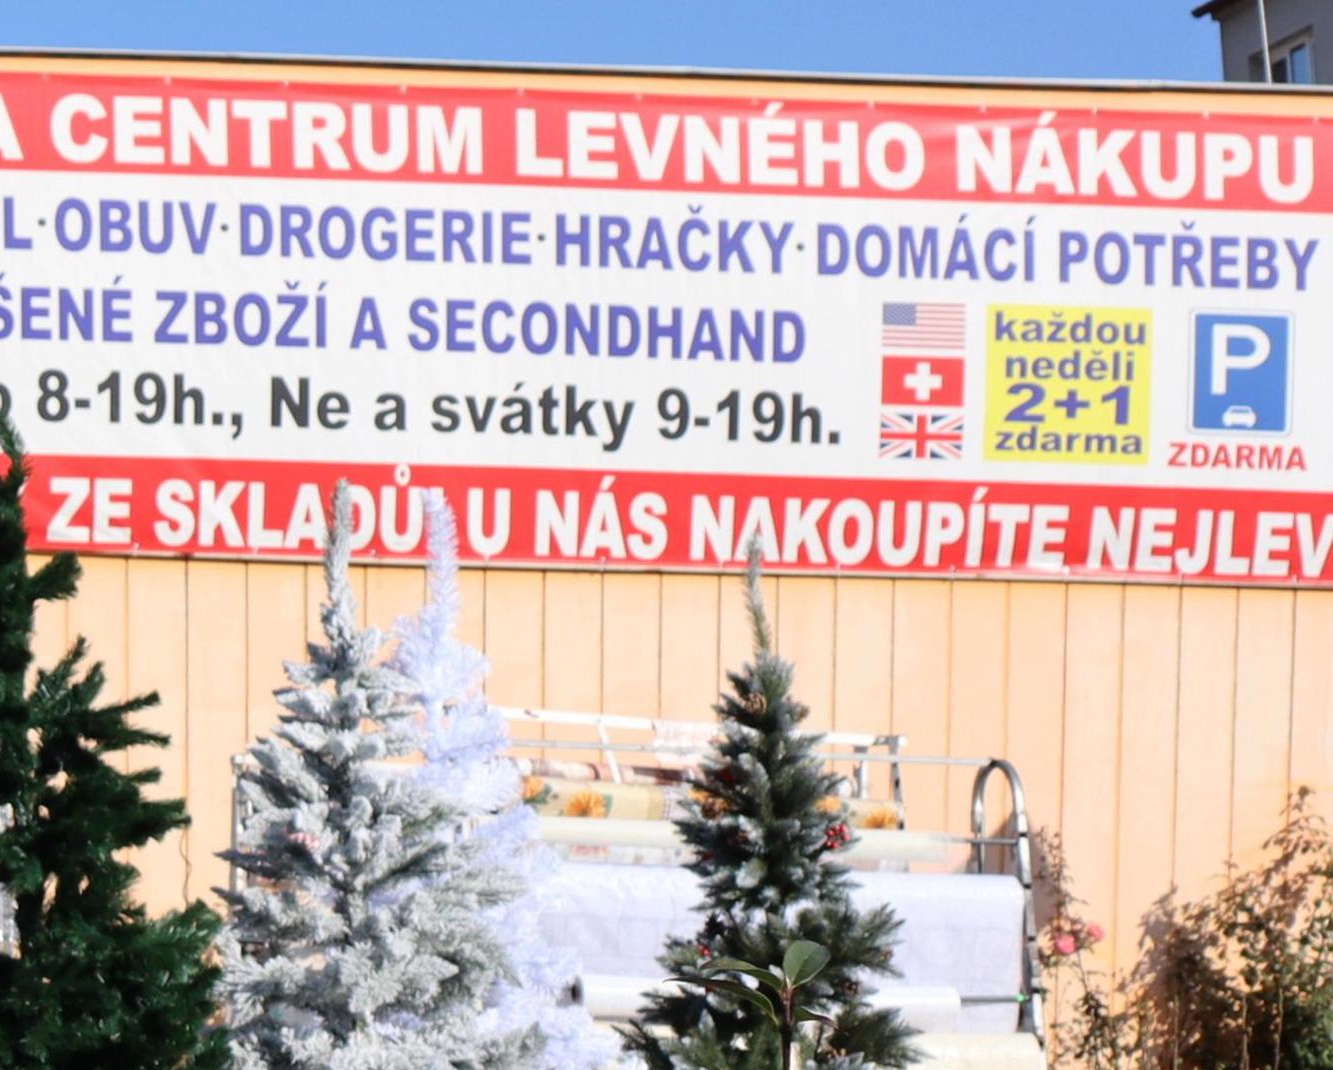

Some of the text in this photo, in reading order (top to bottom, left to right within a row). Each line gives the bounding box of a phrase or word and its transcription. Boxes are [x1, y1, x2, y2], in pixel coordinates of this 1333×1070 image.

[50, 93, 483, 174] CENTRUM
[515, 103, 925, 189] LEVNÉHO
[956, 112, 1315, 203] NÁKUPU
[1059, 222, 1319, 291] POTŘEBY
[154, 282, 327, 349] ZBOŽÍ
[350, 296, 387, 350] A
[408, 297, 807, 364] SECONDHAND
[994, 311, 1146, 345] každou
[1005, 350, 1135, 381] neděli
[1210, 322, 1271, 396] P
[37, 369, 244, 439] 8-19h.,
[270, 377, 350, 430] Ne
[374, 393, 407, 432] a
[432, 383, 634, 452] svátky
[657, 388, 842, 445] 9-19h.
[1004, 383, 1131, 425] 2+1
[994, 426, 1142, 455] zdarma
[1167, 442, 1308, 472] ZDARMA
[46, 477, 134, 544] ZE
[153, 463, 426, 553] SKLADŮ
[466, 488, 511, 557] U
[536, 476, 669, 560] NÁS
[689, 486, 1070, 570] NAKOUPÍTE
[1085, 506, 1333, 577] NEJLEV
